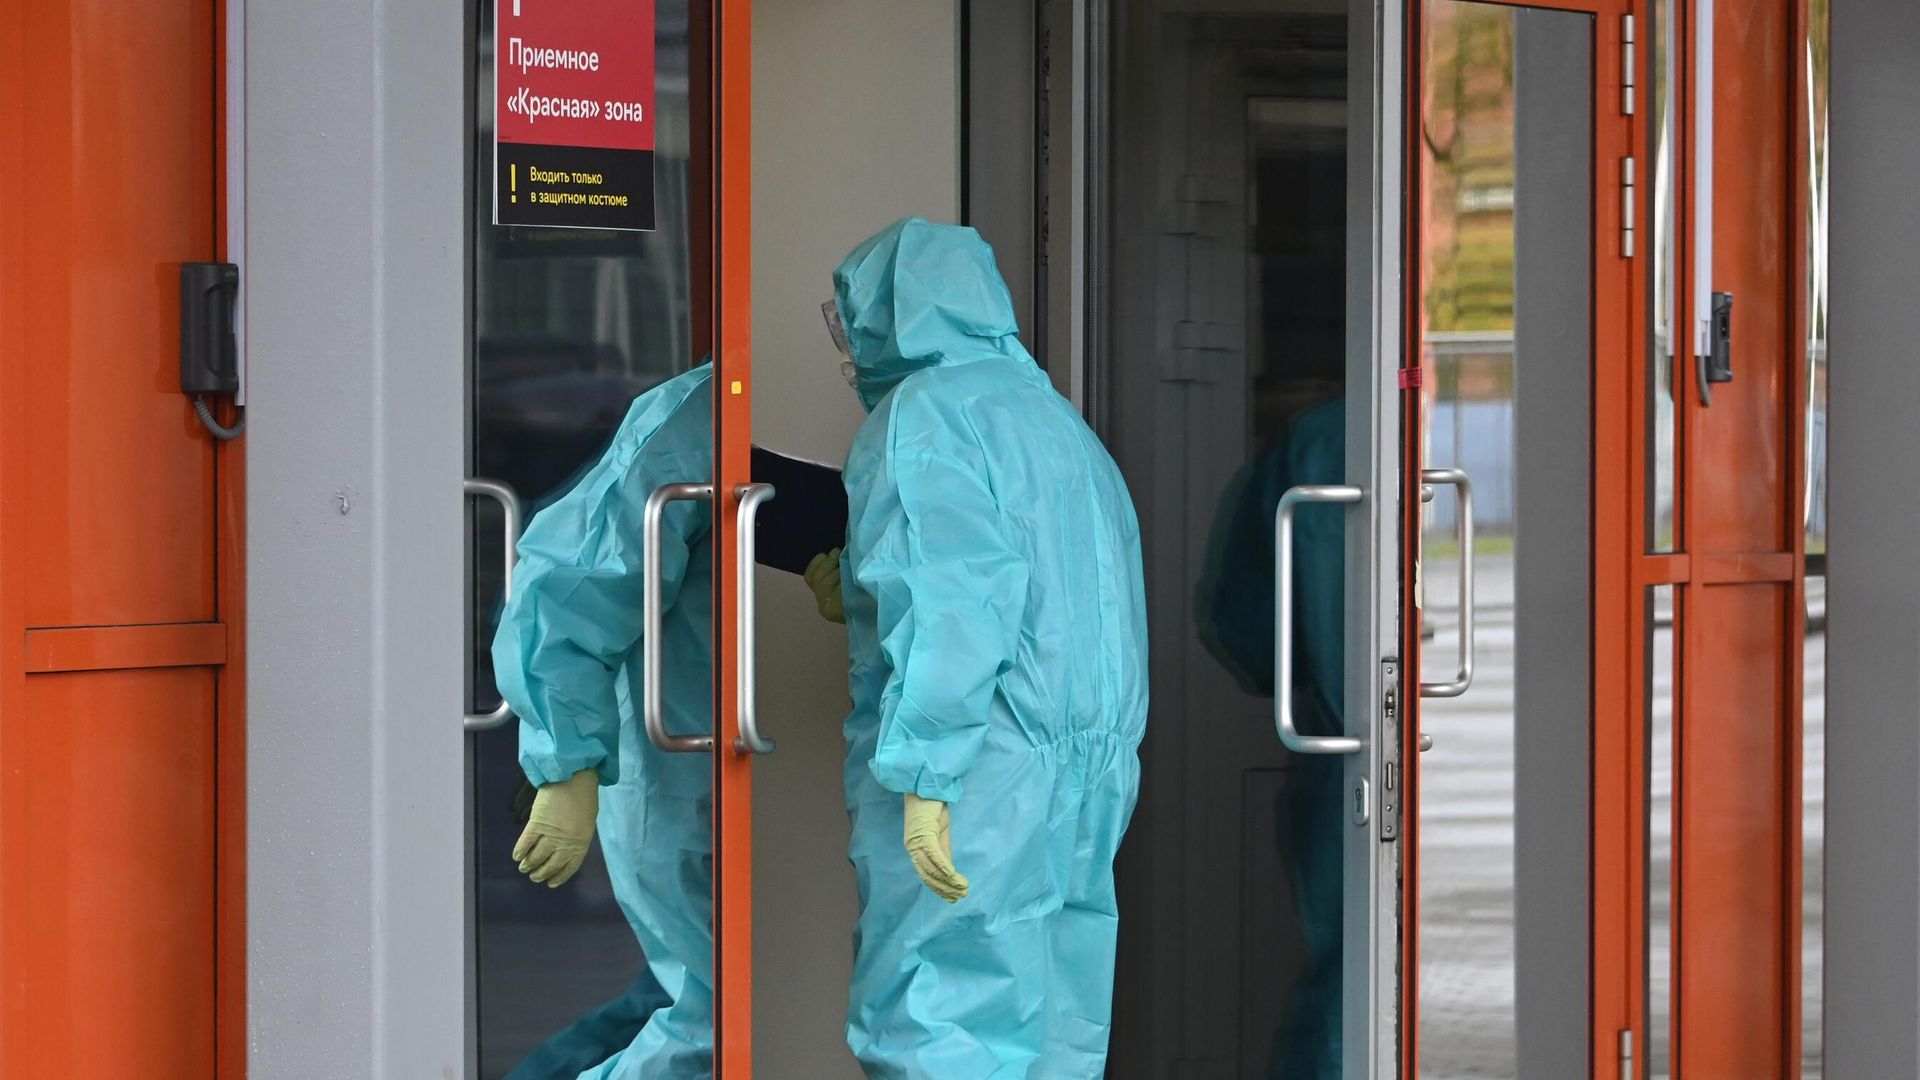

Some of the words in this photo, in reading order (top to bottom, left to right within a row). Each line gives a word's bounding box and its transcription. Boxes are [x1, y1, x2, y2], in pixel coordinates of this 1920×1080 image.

[509, 37, 599, 75] Приемное
[507, 87, 600, 124] «Красная»
[604, 100, 643, 122] зона
[530, 166, 569, 184] Входить
[571, 171, 603, 185] только
[530, 191, 537, 203] в
[539, 191, 587, 206] защитном
[588, 193, 628, 207] костюме
